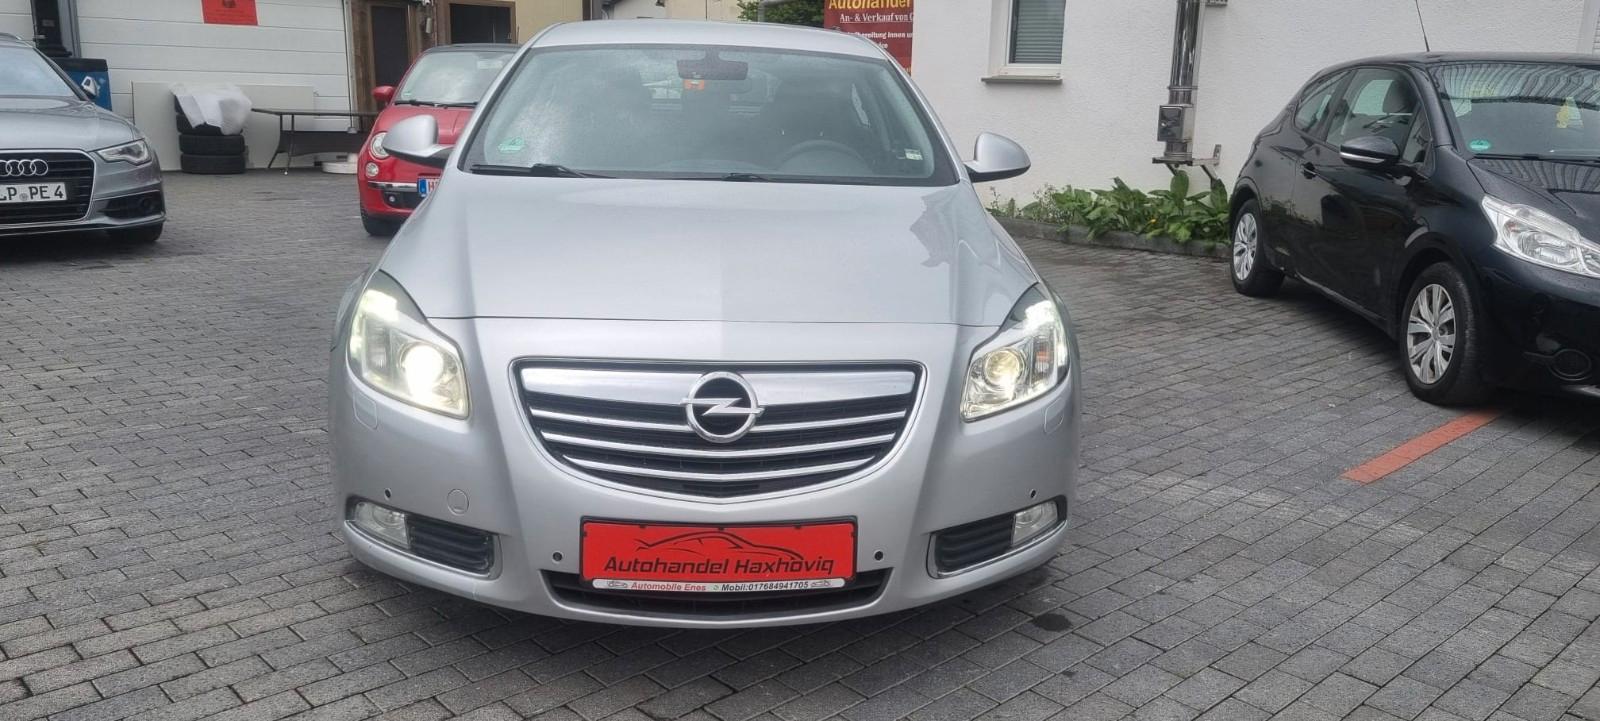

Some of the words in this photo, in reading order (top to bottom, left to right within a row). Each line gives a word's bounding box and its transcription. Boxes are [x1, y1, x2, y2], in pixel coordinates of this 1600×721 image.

[854, 13, 861, 22] &
[862, 12, 894, 22] Verkauf
[28, 186, 50, 199] PE
[54, 185, 64, 199] 4
[604, 556, 728, 575] Autohandel
[631, 582, 681, 591] Automobile
[684, 583, 706, 591] Enes
